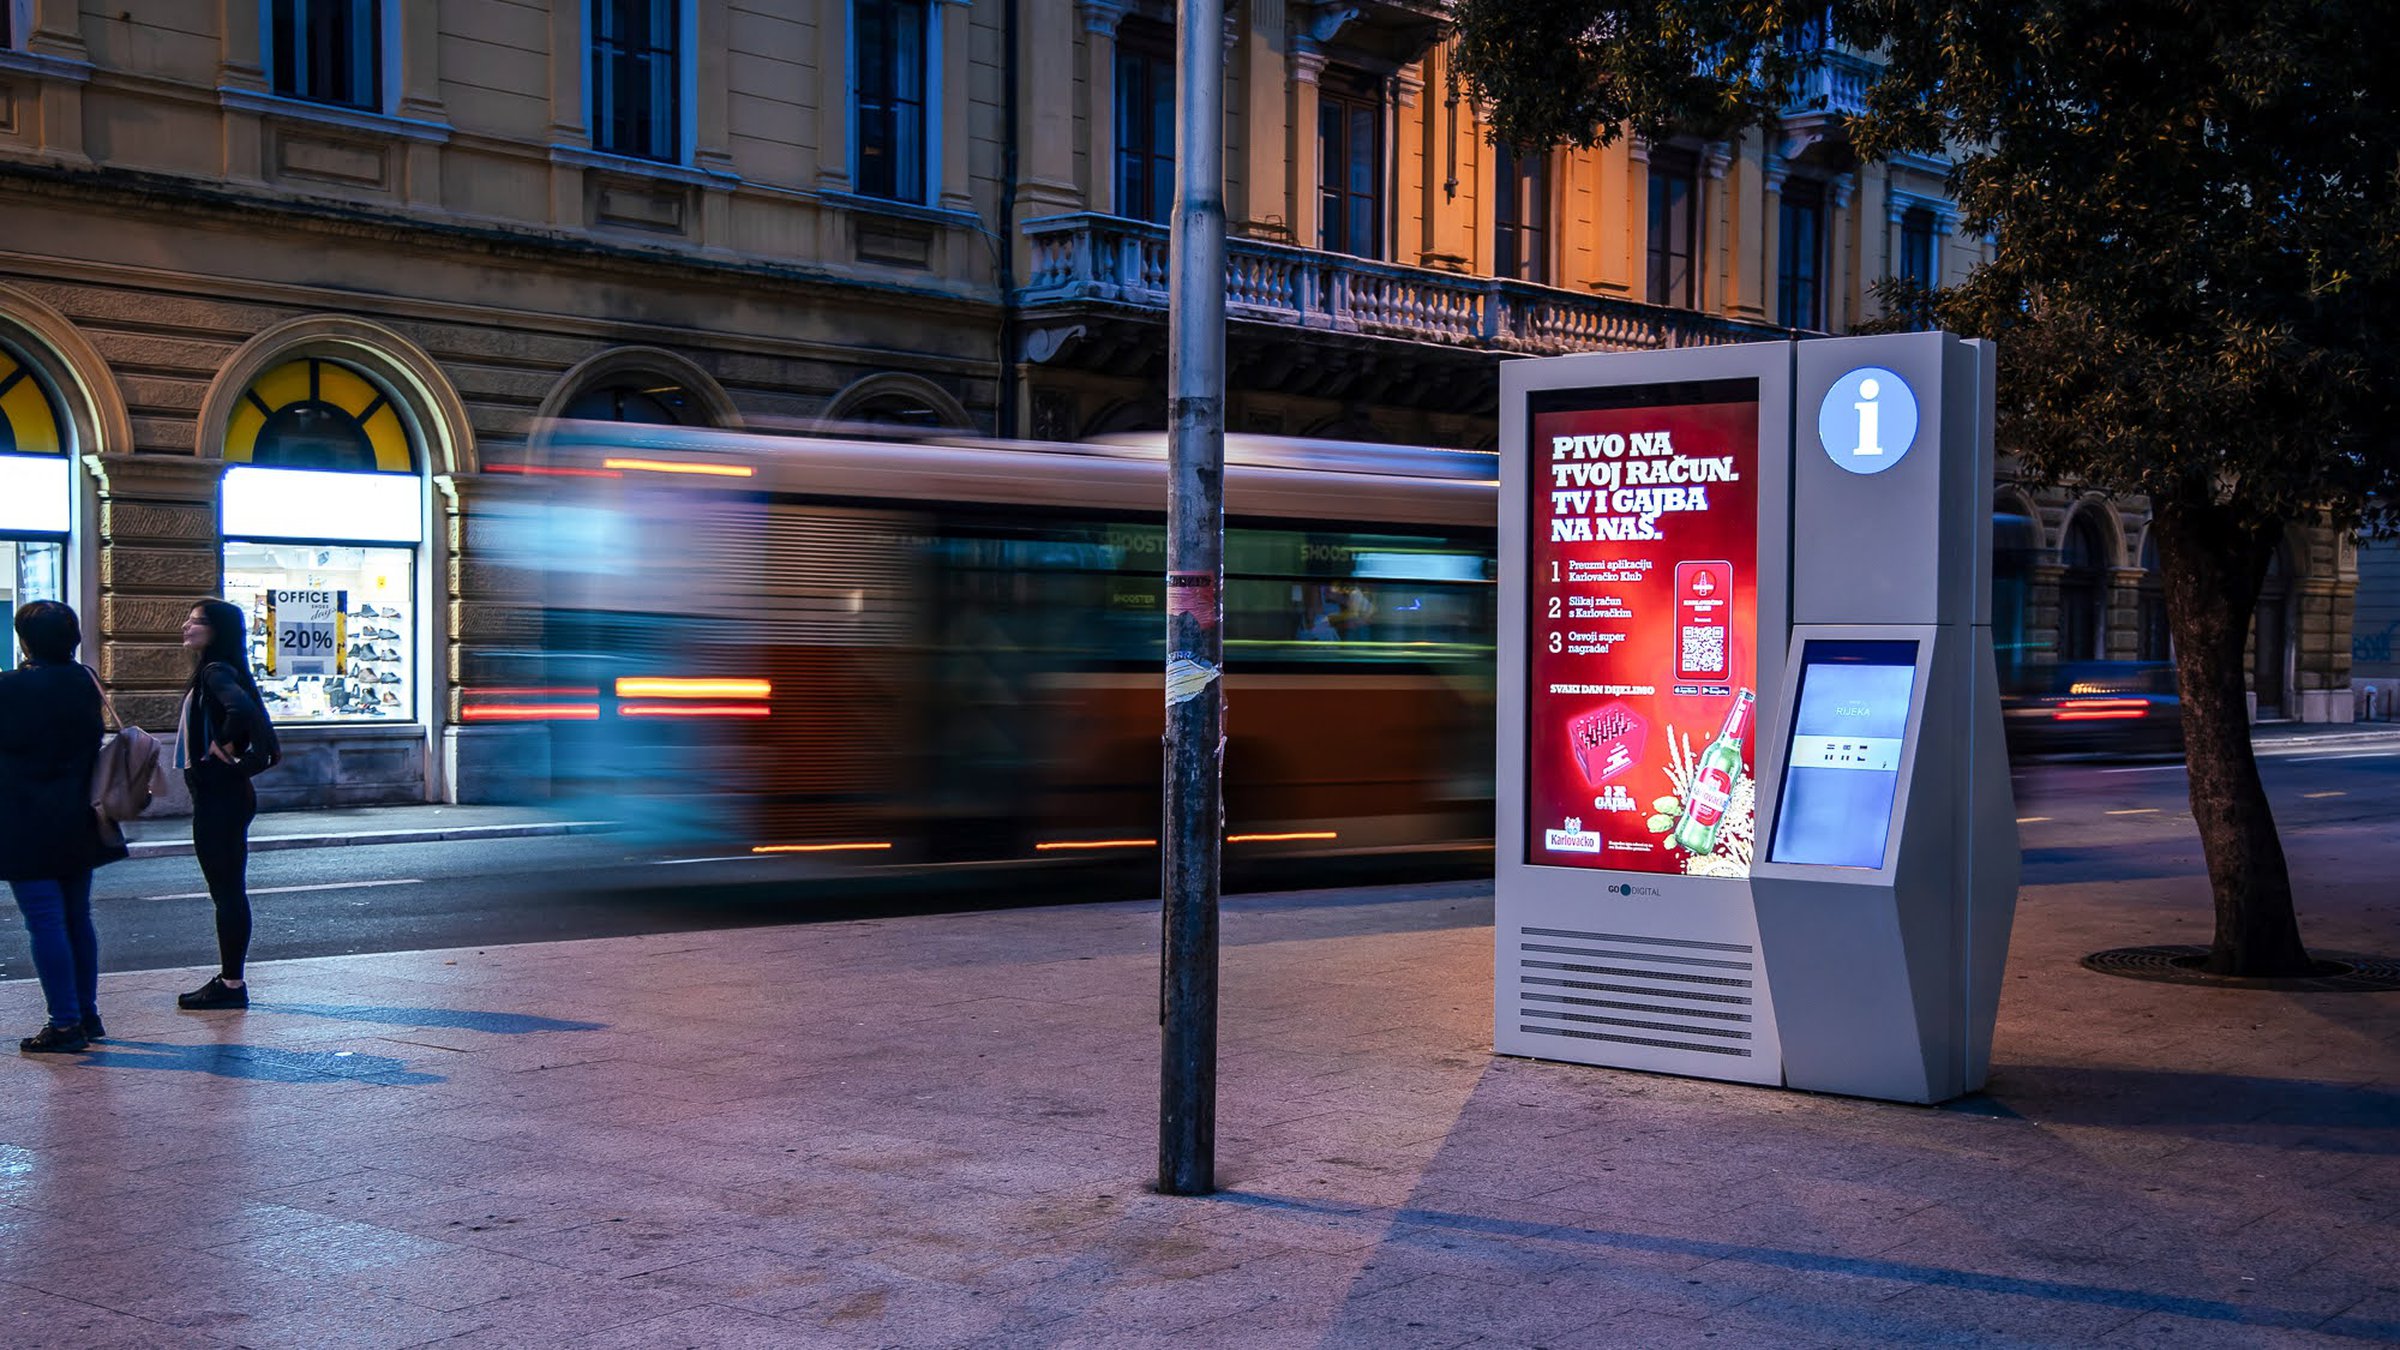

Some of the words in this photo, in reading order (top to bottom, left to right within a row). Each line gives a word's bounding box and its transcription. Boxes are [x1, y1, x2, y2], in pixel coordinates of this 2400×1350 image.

[1853, 378, 1883, 456] i
[1552, 434, 1625, 460] PIVO
[1629, 432, 1673, 457] NA
[1552, 461, 1622, 492] TVOJ
[1625, 454, 1739, 485] RAČUN.
[1552, 491, 1592, 514] TV
[1595, 490, 1607, 514] I
[1612, 486, 1708, 518] GAJBA
[1551, 518, 1592, 542] NA
[1596, 512, 1663, 541] NAŠ.
[1551, 561, 1561, 582] 1
[1569, 560, 1605, 570] Preuzmi
[1607, 559, 1653, 571] aplikaciju
[1569, 572, 1619, 582] Karlovačko
[1620, 572, 1642, 581] Klub
[278, 591, 329, 603] OFFICE
[311, 607, 337, 620] days
[1548, 596, 1562, 619] 2
[1569, 597, 1594, 607] Slikaj
[1595, 597, 1622, 606] račun
[1576, 608, 1632, 618] Karlovačkim
[279, 630, 333, 649] -20%
[1549, 632, 1562, 653] 3
[1568, 631, 1597, 643] Osvoji
[1598, 633, 1626, 643] super
[1550, 684, 1580, 694] SVAKI
[1581, 685, 1604, 694] DAN
[1604, 685, 1655, 697] DIJELIMO
[1836, 707, 1871, 716] RIJEKA
[1551, 834, 1595, 848] Karlovačko
[1608, 885, 1620, 893] GO
[1631, 887, 1662, 897] DIGITAL
